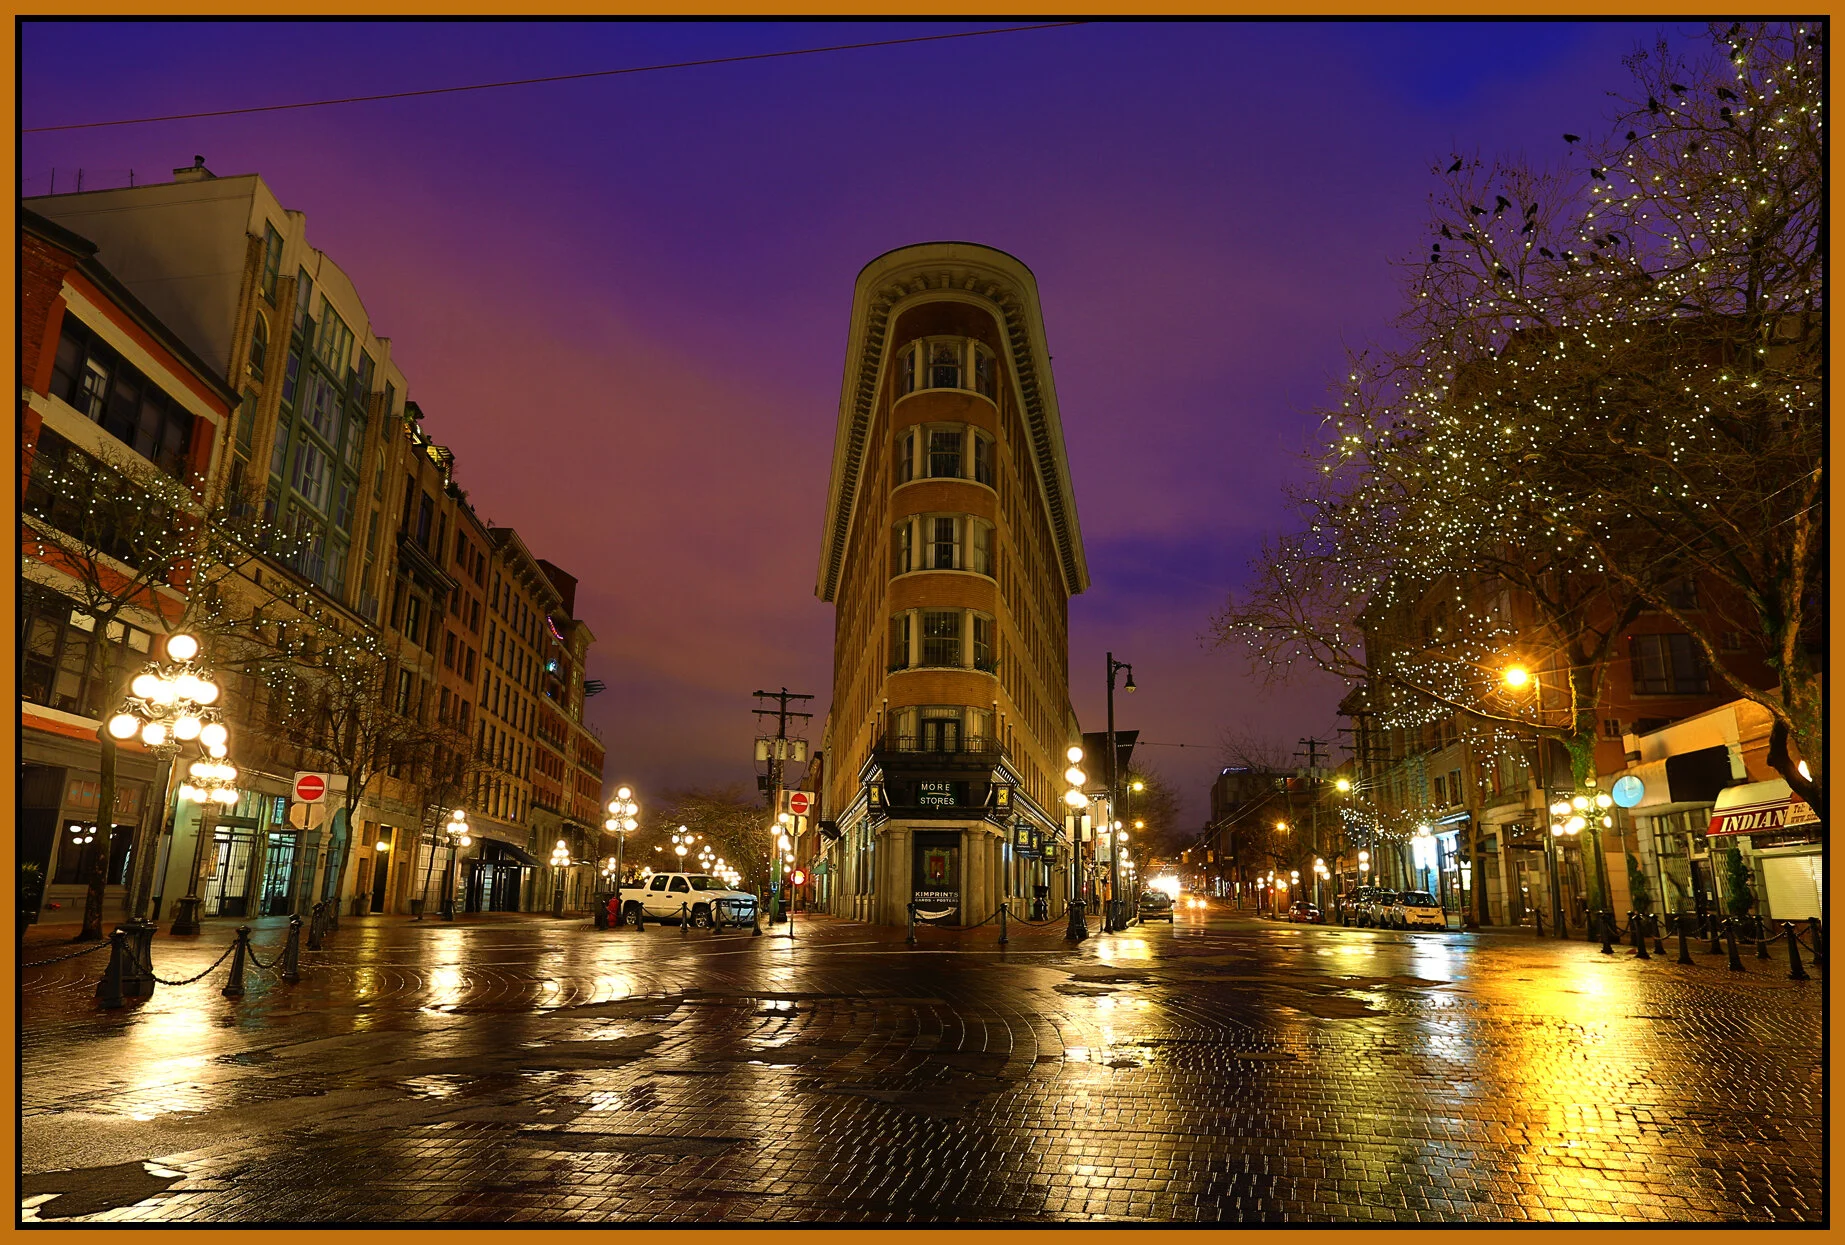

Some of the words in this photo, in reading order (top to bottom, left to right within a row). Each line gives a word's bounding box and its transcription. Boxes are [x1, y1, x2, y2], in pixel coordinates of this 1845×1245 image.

[921, 783, 950, 791] MORE
[920, 797, 954, 805] STORES
[1719, 809, 1788, 833] INDIAN
